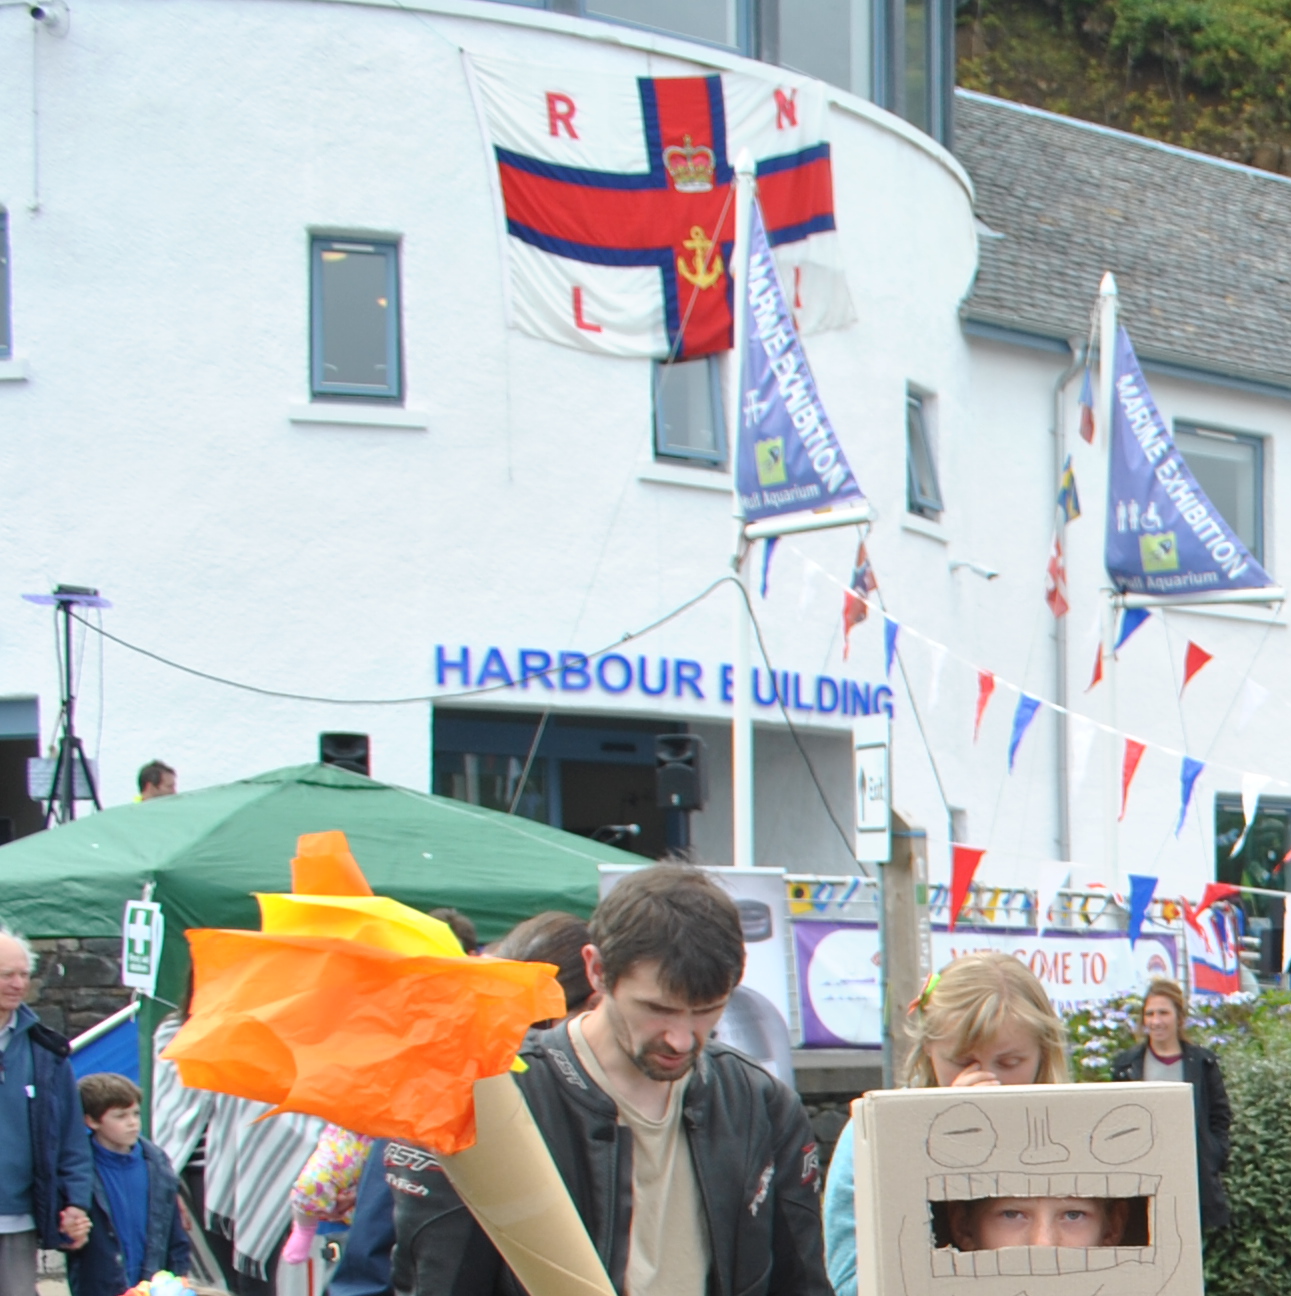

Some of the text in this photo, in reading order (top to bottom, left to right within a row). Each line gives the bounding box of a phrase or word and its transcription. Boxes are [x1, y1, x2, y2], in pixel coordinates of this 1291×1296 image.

[545, 90, 798, 140] R N
[572, 286, 602, 333] L
[762, 482, 820, 508] Aquarium
[1116, 373, 1249, 580] MARINE EXHIBITION
[1146, 570, 1219, 592] Aquarium
[435, 645, 705, 700] HARBOUR
[1081, 952, 1107, 984] TO
[384, 1142, 442, 1171] RST
